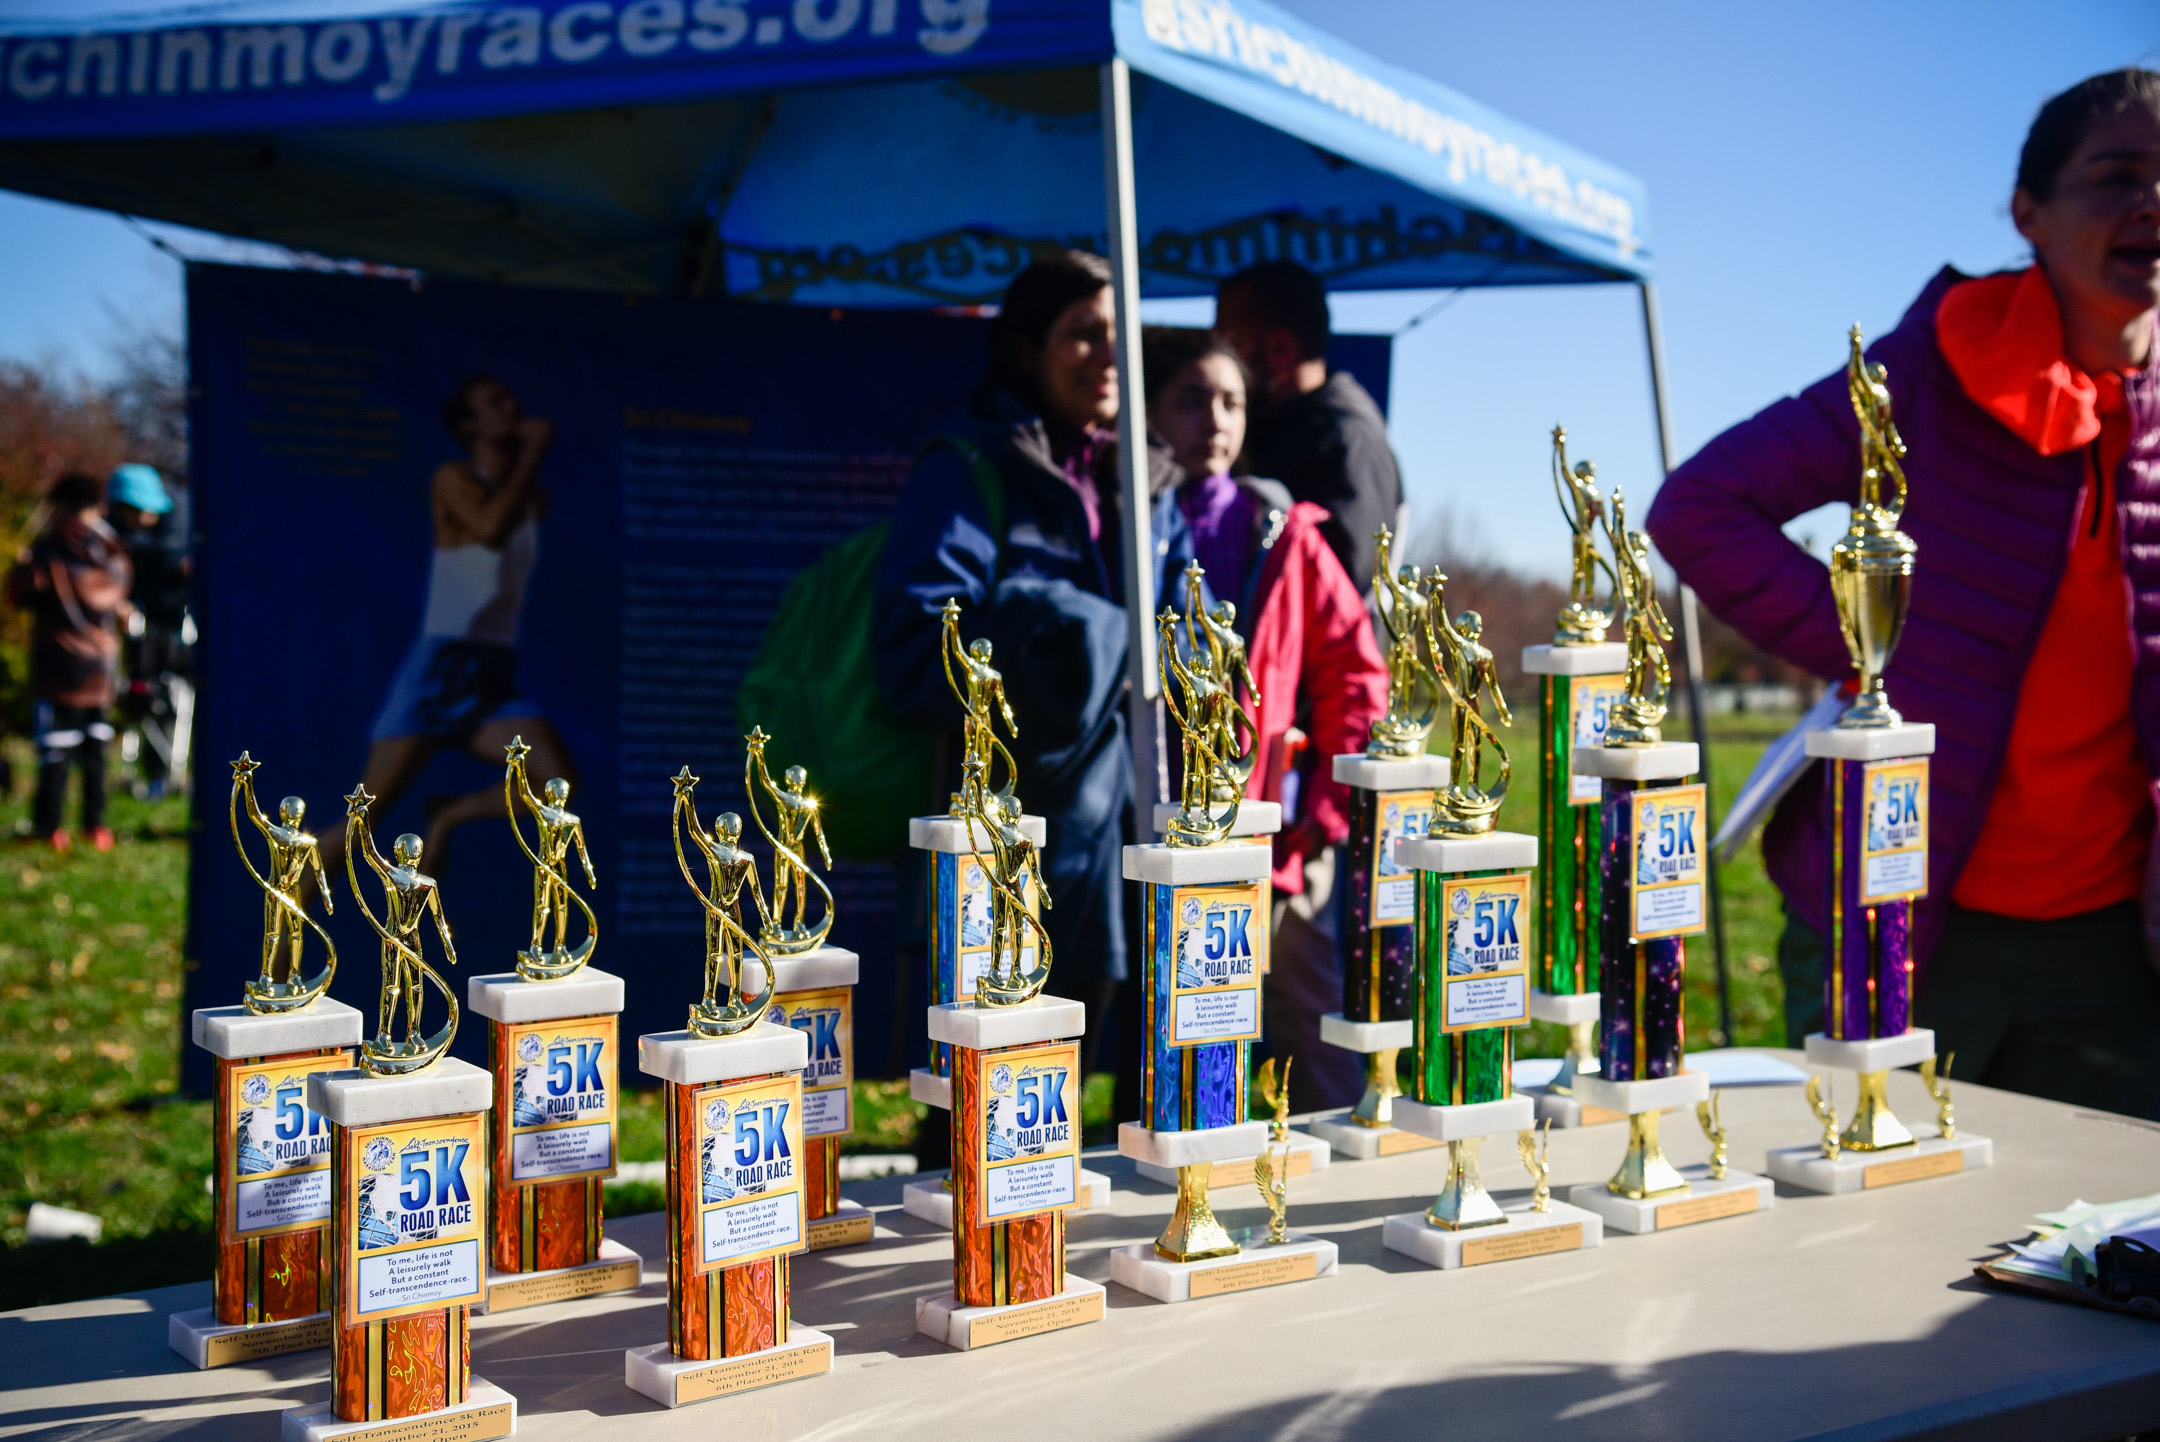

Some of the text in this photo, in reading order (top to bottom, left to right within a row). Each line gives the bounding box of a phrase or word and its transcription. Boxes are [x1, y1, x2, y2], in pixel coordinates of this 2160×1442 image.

[1887, 782, 1918, 825] 5K
[1659, 811, 1695, 858] 5K
[1474, 898, 1518, 948] 5K
[1205, 909, 1252, 961] 5K
[1475, 946, 1519, 964] ROAD RACE
[1205, 959, 1251, 977] ROAD RACE
[547, 1042, 604, 1097] 5K
[818, 1060, 842, 1076] RACE
[548, 1093, 604, 1114] ROAD RACE
[1016, 1071, 1068, 1129] 5K
[372, 1137, 394, 1146] CHINMOY
[735, 1103, 791, 1166] 5K
[1017, 1124, 1068, 1147] ROAD RACE
[276, 1135, 330, 1160] ROAD RAC
[399, 1136, 468, 1153] Self-Transcendence
[544, 1140, 571, 1149] leisurely
[558, 1147, 585, 1155] constant
[362, 1153, 396, 1172] MARATHON TEAM
[400, 1144, 470, 1211] 5K
[736, 1159, 792, 1187] ROAD RACE
[1015, 1174, 1039, 1183] leisurely
[273, 1187, 303, 1197] leisurely
[1027, 1180, 1052, 1189] constant
[288, 1193, 319, 1202] constant
[247, 1201, 330, 1217] Self-transcendence-rac
[734, 1214, 761, 1225] leisurely
[763, 1210, 777, 1218] walk
[749, 1205, 759, 1213] life
[401, 1204, 470, 1232] ROAD RACE
[748, 1220, 775, 1230] constant
[713, 1226, 792, 1248] Self-transcendence-race.
[747, 1239, 770, 1249] Chinmoy
[416, 1253, 429, 1261] life
[397, 1263, 431, 1274] leisurely
[433, 1259, 450, 1267] walk
[414, 1269, 448, 1280] constant
[370, 1277, 469, 1297] Self-transcendence-race.
[575, 1285, 603, 1294] Open
[402, 1290, 442, 1302] Sri Chinmoy
[975, 1304, 1064, 1326] Self-Transcendence
[996, 1315, 1043, 1330] November
[1021, 1324, 1044, 1332] Place
[1047, 1318, 1072, 1326] Open
[307, 1337, 330, 1345] Ope
[682, 1354, 785, 1381] Self-Transcendence
[803, 1346, 826, 1355] Race
[706, 1368, 762, 1384] November
[781, 1359, 804, 1368] 2015
[716, 1370, 794, 1391] 6th Place Open
[332, 1407, 507, 1442] Self-Transcendence 5k Race
[452, 1422, 479, 1432] 2015
